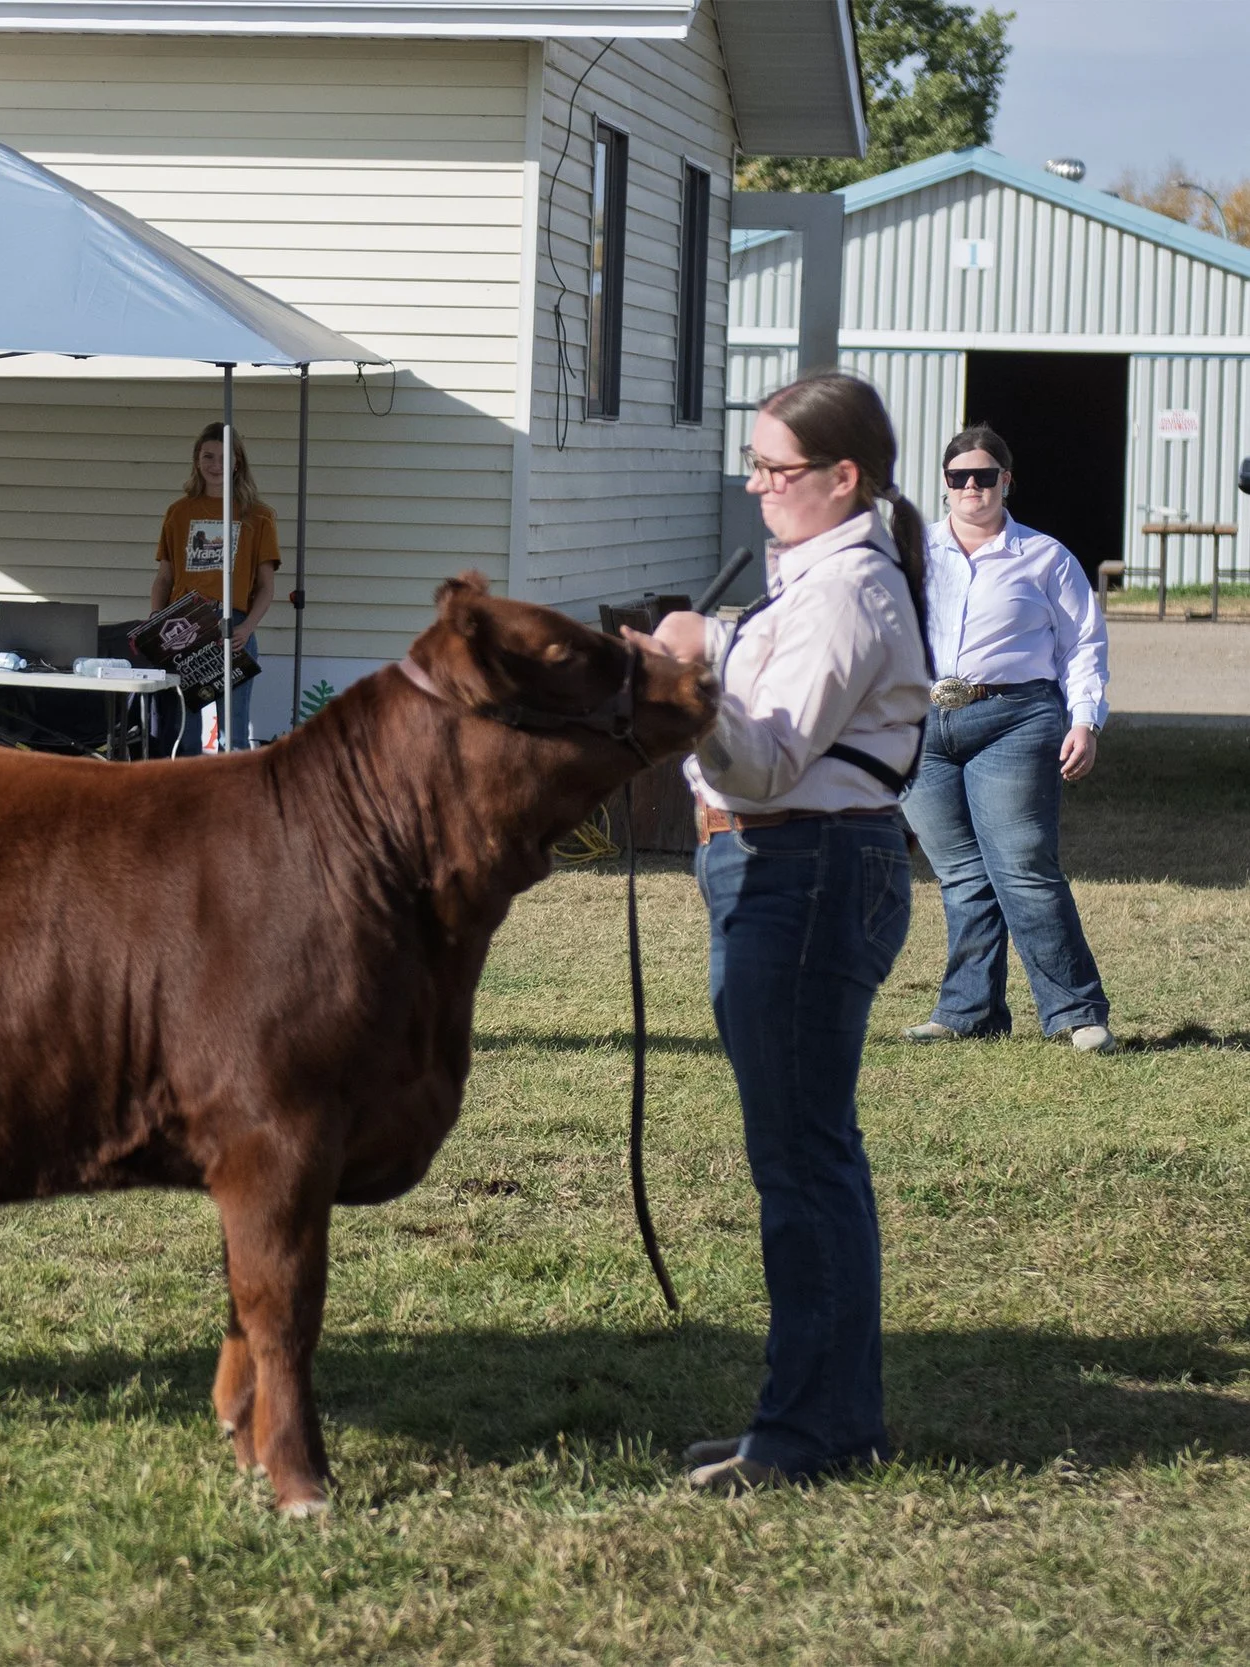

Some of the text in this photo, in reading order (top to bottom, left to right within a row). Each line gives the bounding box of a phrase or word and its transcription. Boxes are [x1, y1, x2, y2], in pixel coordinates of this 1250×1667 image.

[185, 546, 237, 562] Wrang
[173, 641, 217, 670] Supreme
[180, 645, 223, 676] GRAND
